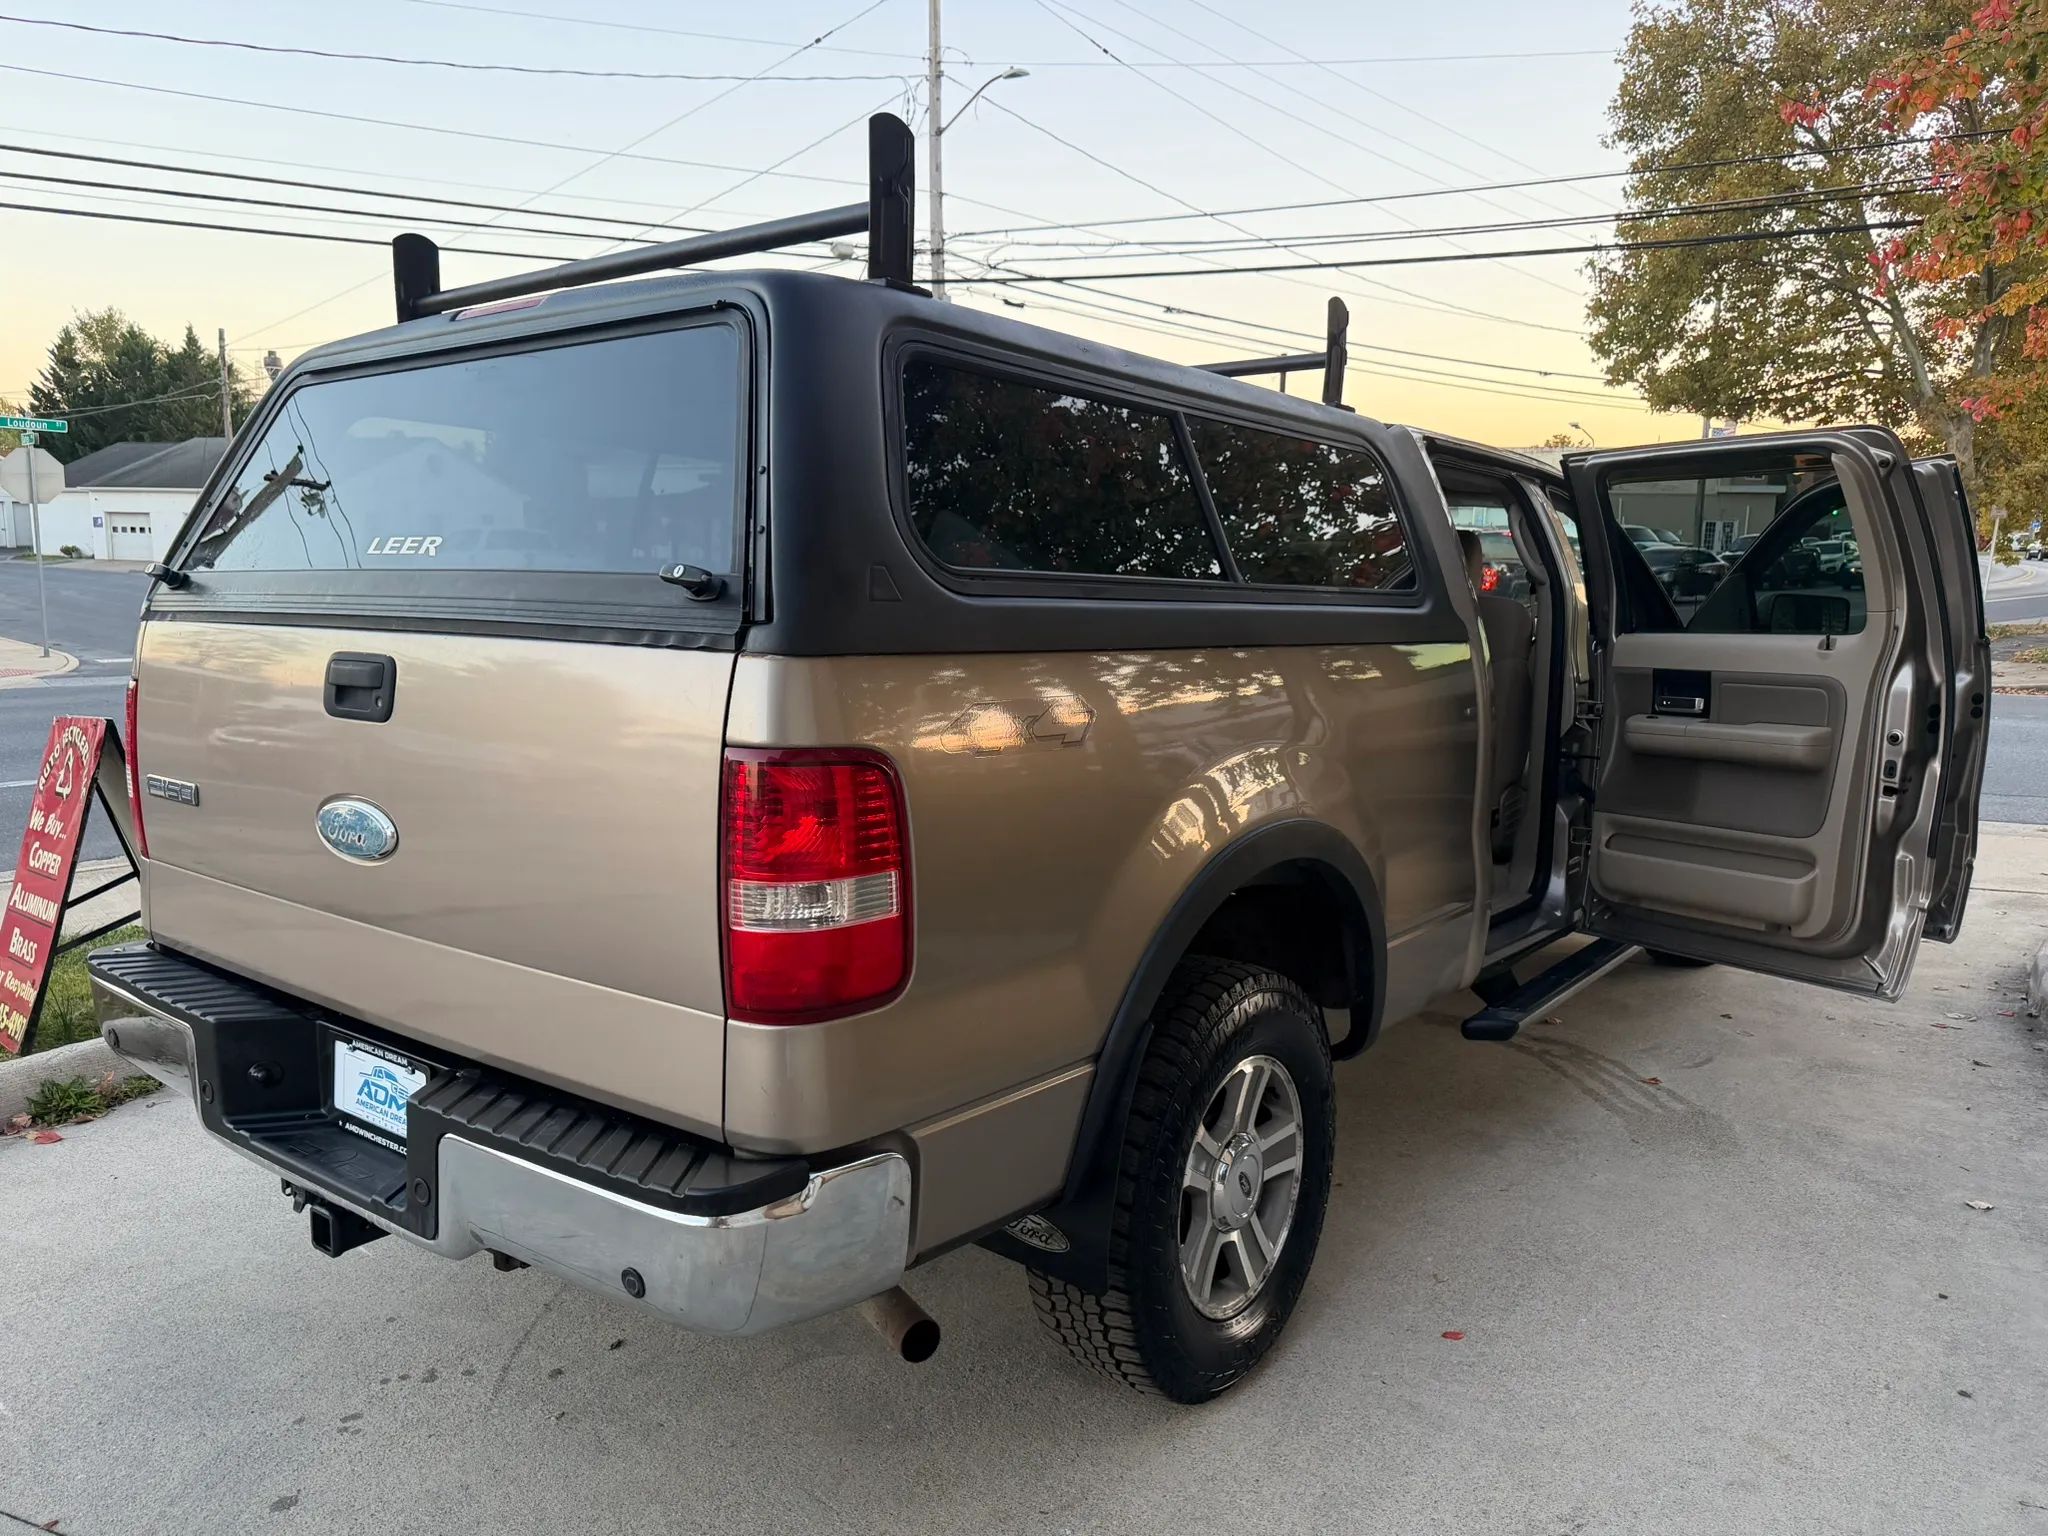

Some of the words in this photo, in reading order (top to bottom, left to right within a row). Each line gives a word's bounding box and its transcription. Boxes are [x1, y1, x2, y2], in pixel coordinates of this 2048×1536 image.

[7, 418, 48, 429] Loudoun
[366, 536, 443, 557] LEER
[39, 743, 60, 791] AUTO
[29, 807, 44, 830] We
[326, 808, 369, 848] Ford
[29, 841, 62, 876] COPPER
[9, 882, 58, 924] ALUMINUM
[9, 927, 37, 964] BRASS
[351, 1039, 384, 1056] AMERICAN
[385, 1051, 408, 1066] DREAM
[357, 1079, 406, 1111] ADM
[356, 1098, 389, 1117] AMERICAN
[390, 1113, 406, 1125] DREA
